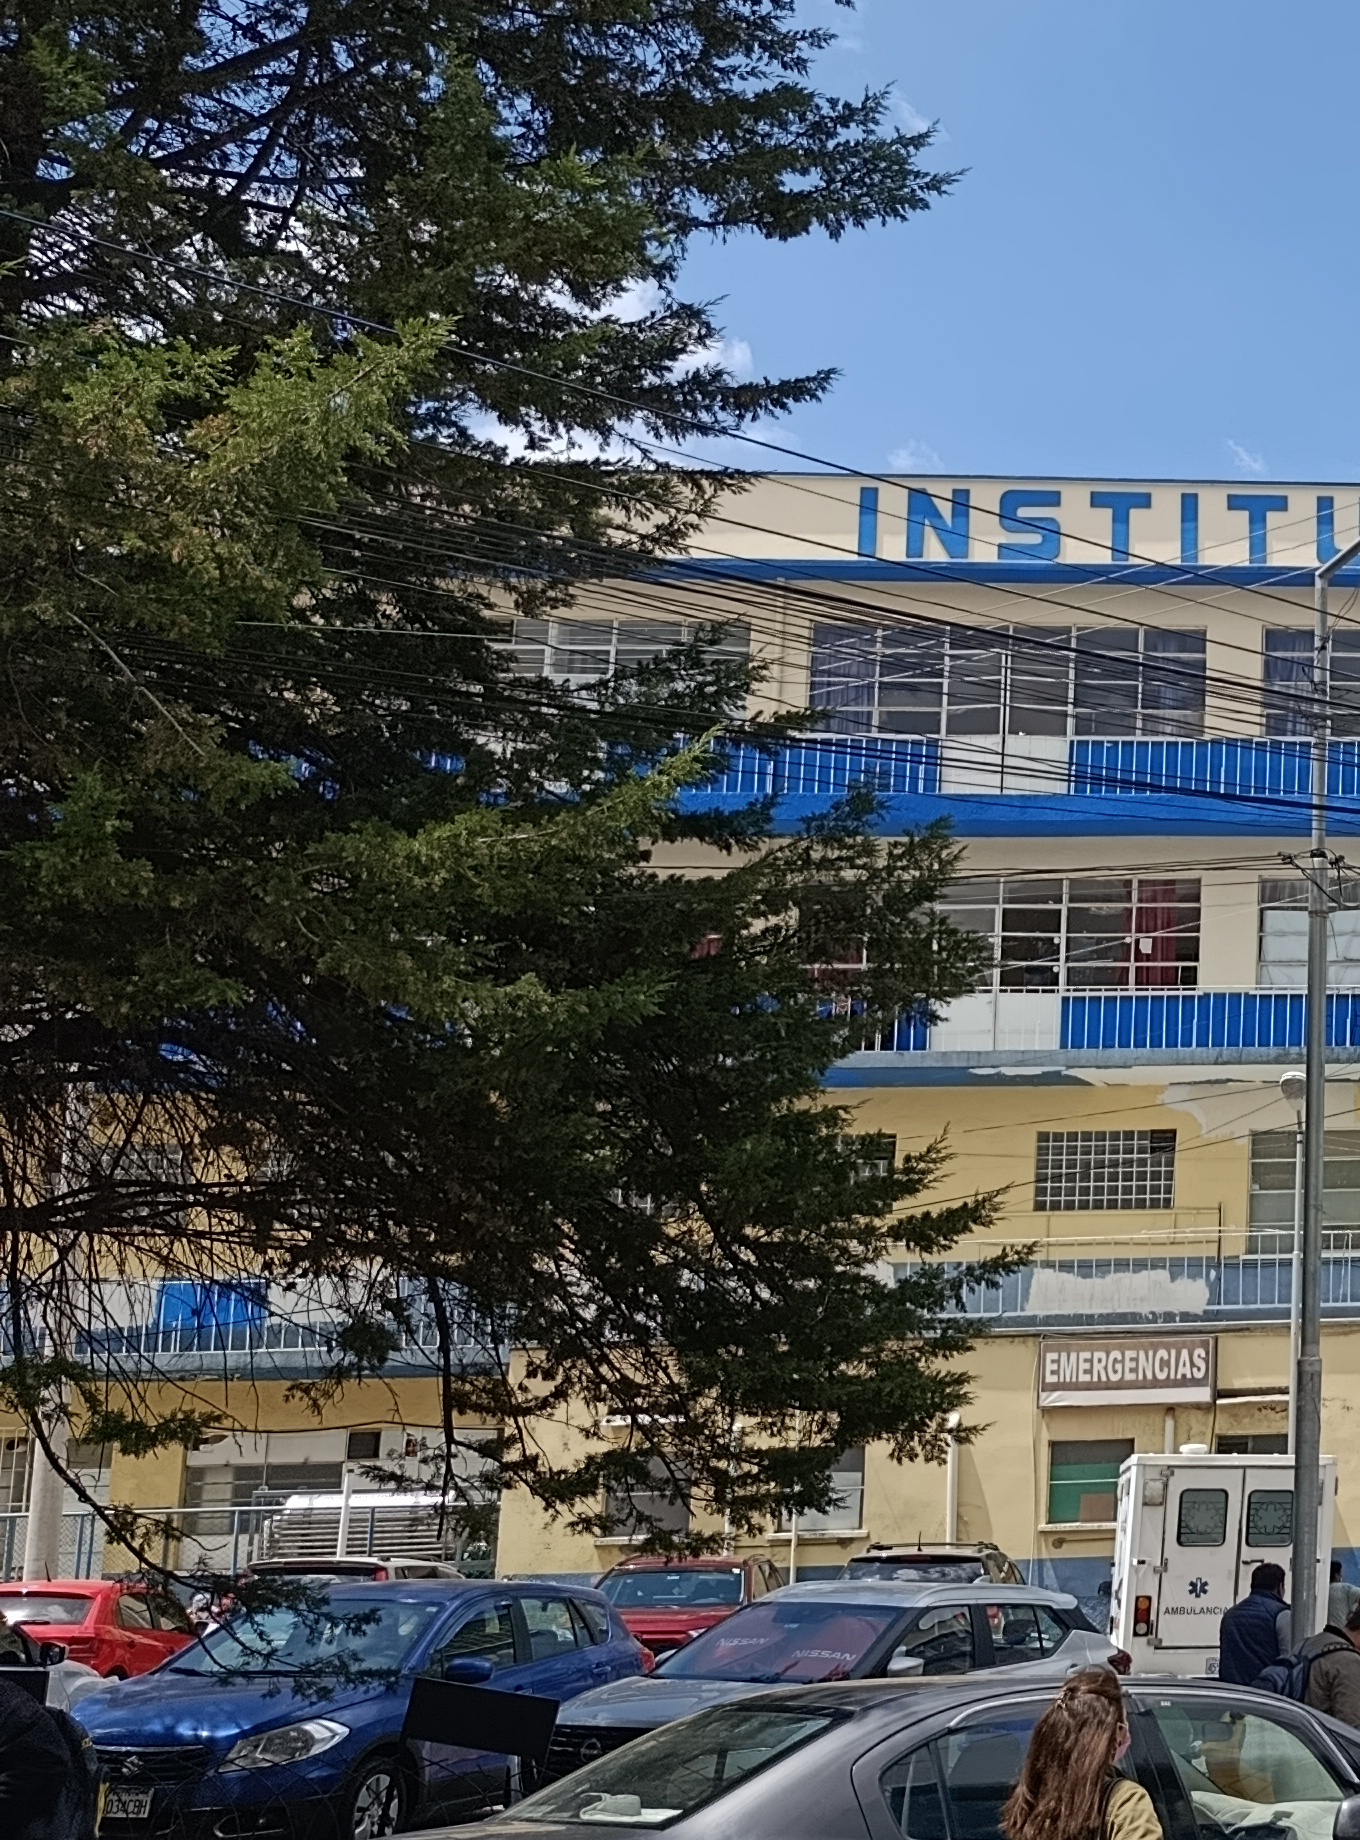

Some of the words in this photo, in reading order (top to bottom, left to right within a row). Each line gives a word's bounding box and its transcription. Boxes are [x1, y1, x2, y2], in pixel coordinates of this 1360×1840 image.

[1045, 1347, 1207, 1383] EMERGENCIAS
[715, 1637, 770, 1647] NISSAN
[791, 1649, 857, 1661] NISSAN
